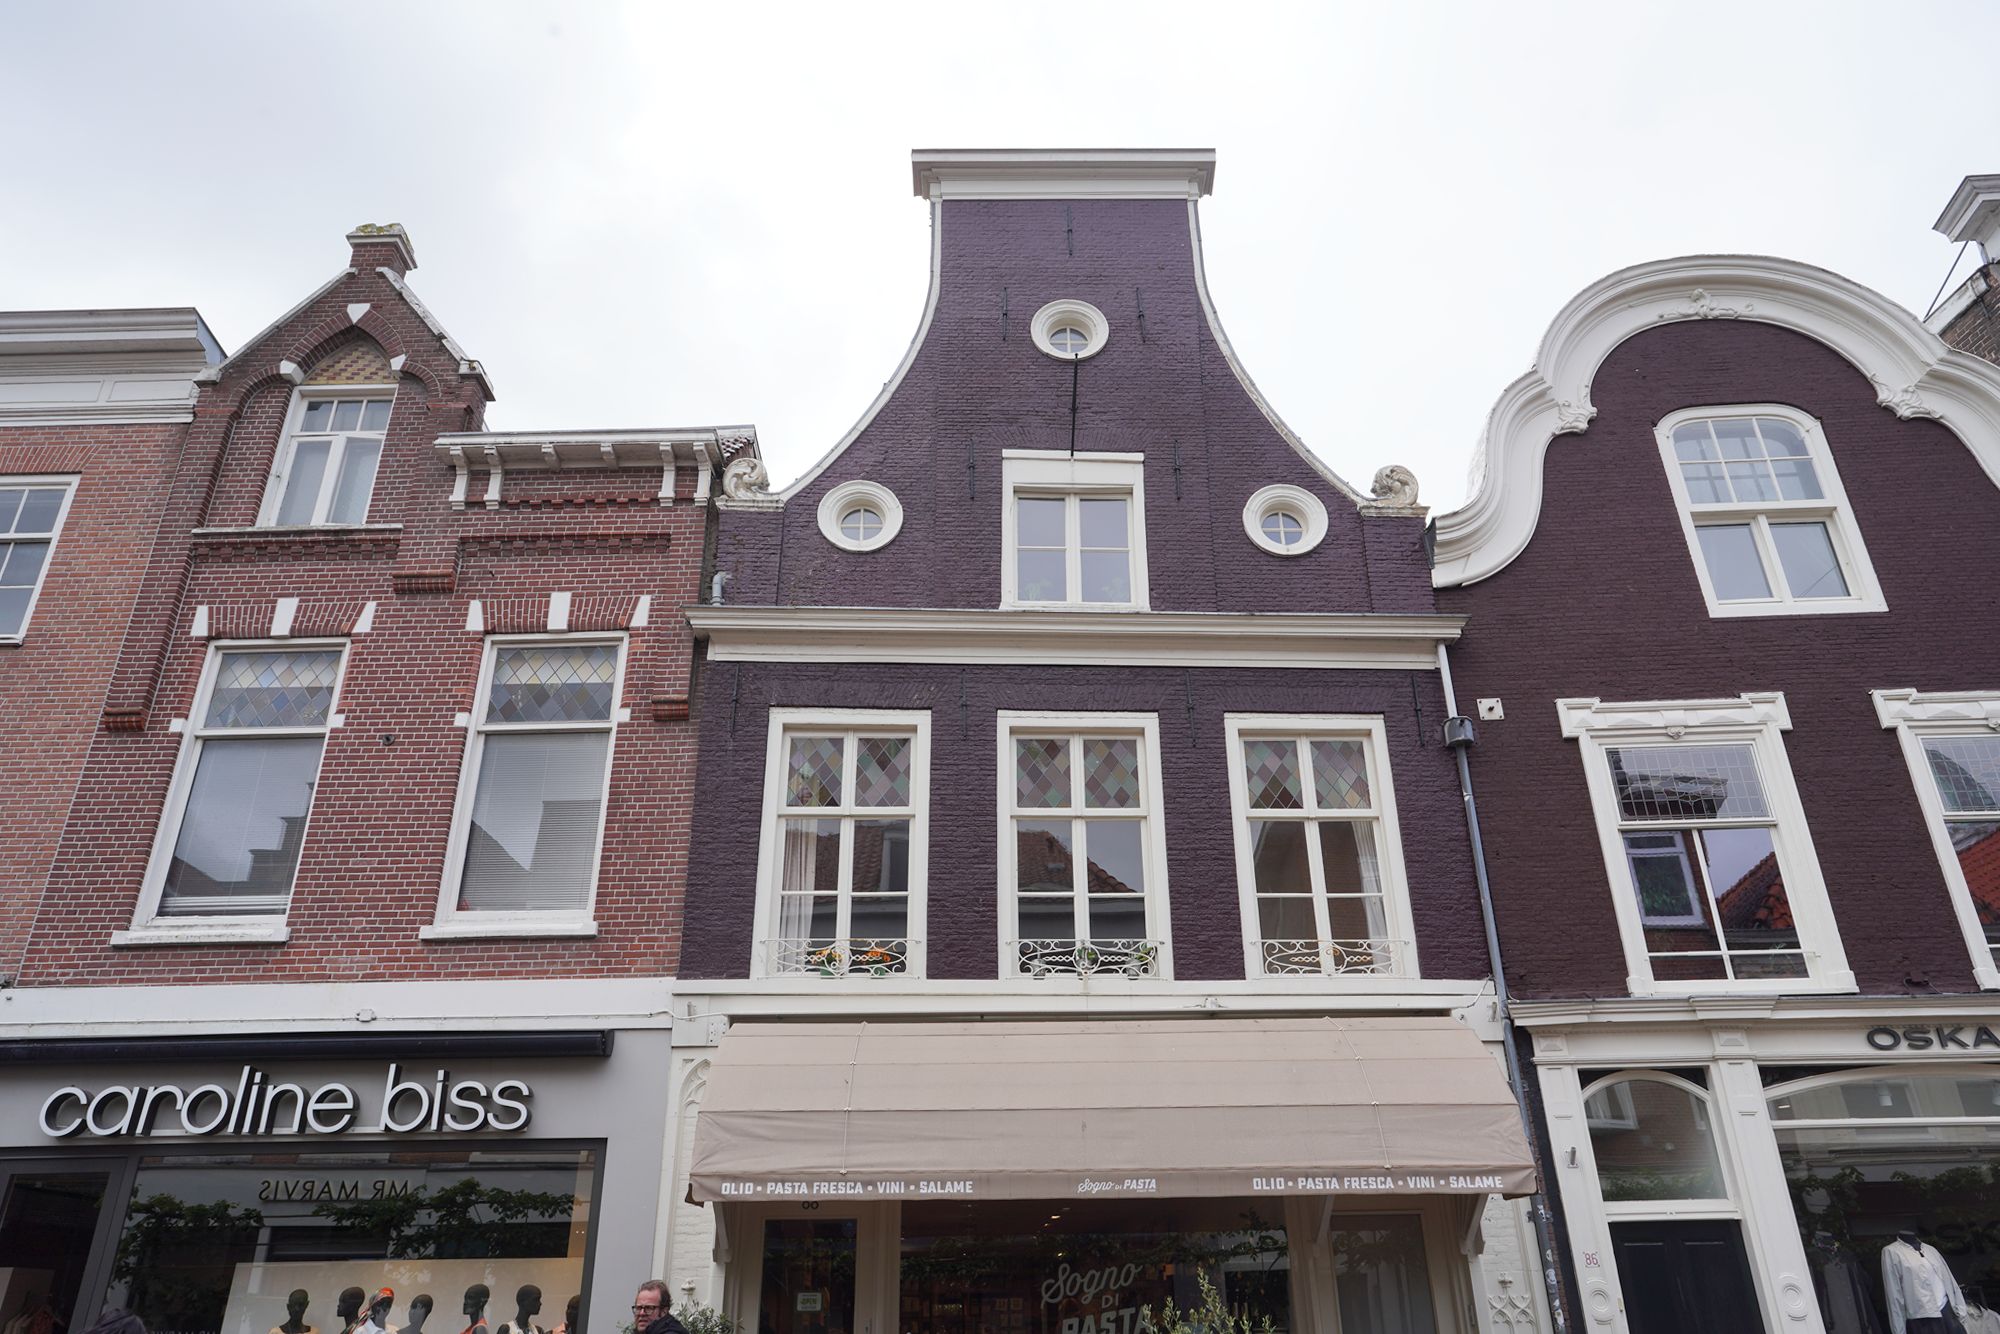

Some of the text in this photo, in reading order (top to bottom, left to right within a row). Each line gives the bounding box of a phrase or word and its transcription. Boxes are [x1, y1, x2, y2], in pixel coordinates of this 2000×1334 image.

[1866, 1024, 2000, 1051] OSKA
[39, 1063, 531, 1138] caroline biss
[721, 1180, 973, 1195] OLIO PASTA FRESCA VINI SALAME
[1077, 1178, 1115, 1194] Sogno
[1123, 1178, 1157, 1190] PASTA
[1252, 1175, 1503, 1190] OLIO PASTA FRESCA VINI SALAME
[1584, 1252, 1599, 1266] 86
[1041, 1263, 1144, 1310] Sogno
[1102, 1293, 1120, 1309] DI
